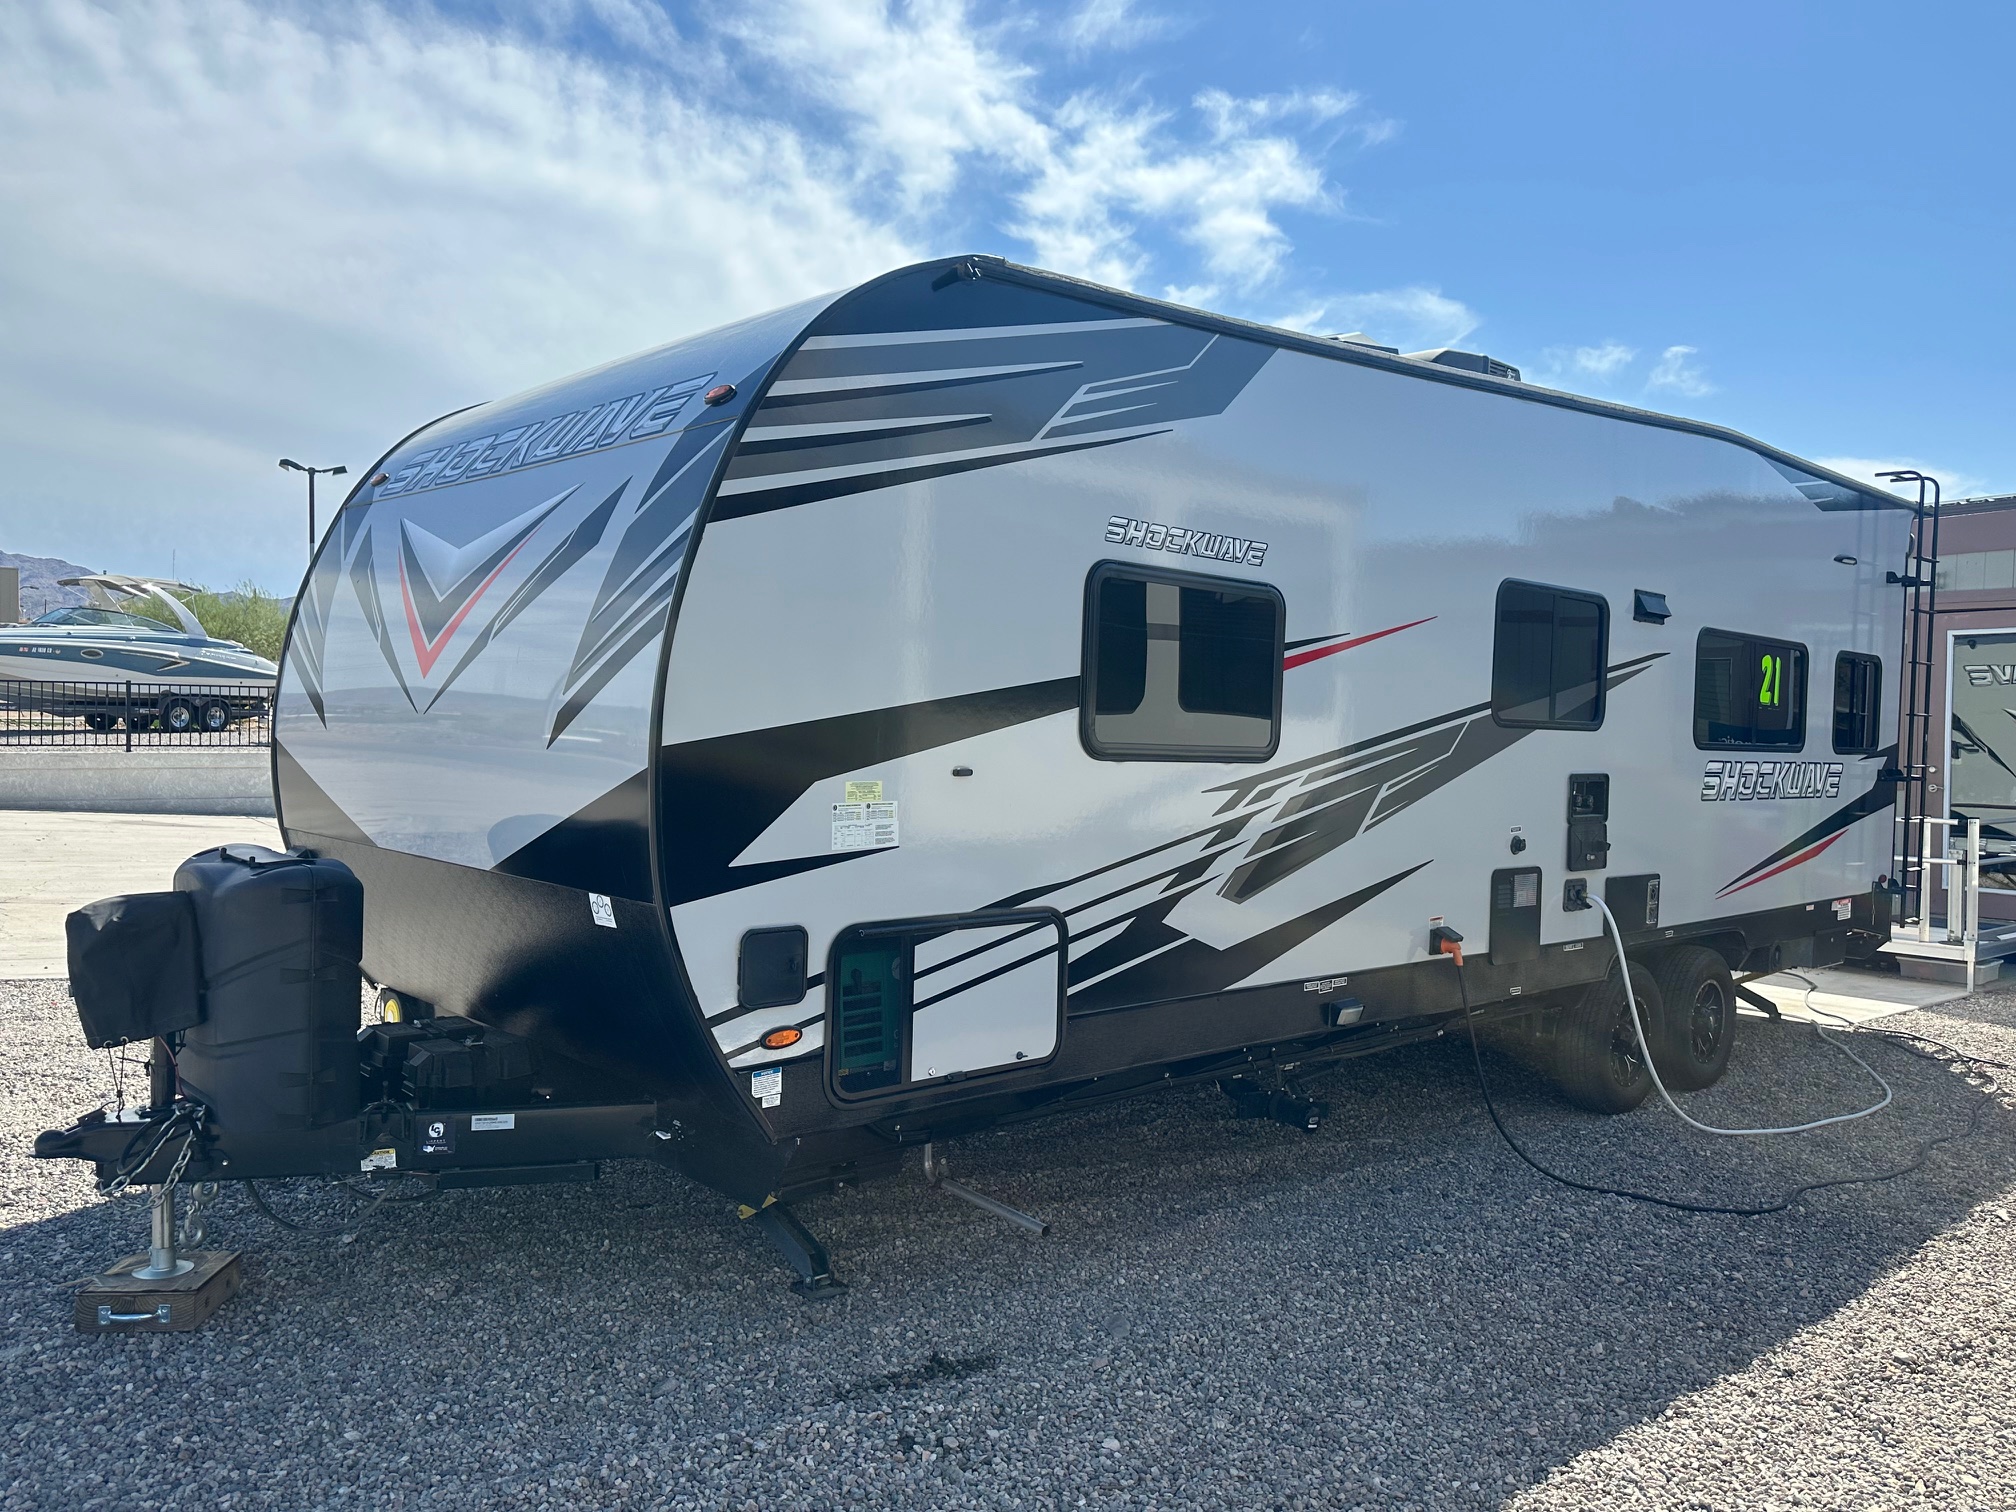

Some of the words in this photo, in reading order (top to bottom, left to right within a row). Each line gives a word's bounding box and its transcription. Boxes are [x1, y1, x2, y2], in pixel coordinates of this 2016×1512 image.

[379, 371, 718, 497] SHOCKWAVE
[1105, 515, 1268, 567] SHOCKWAVE
[1760, 654, 1782, 706] 21
[1701, 760, 1844, 801] SHOCKWAVE
